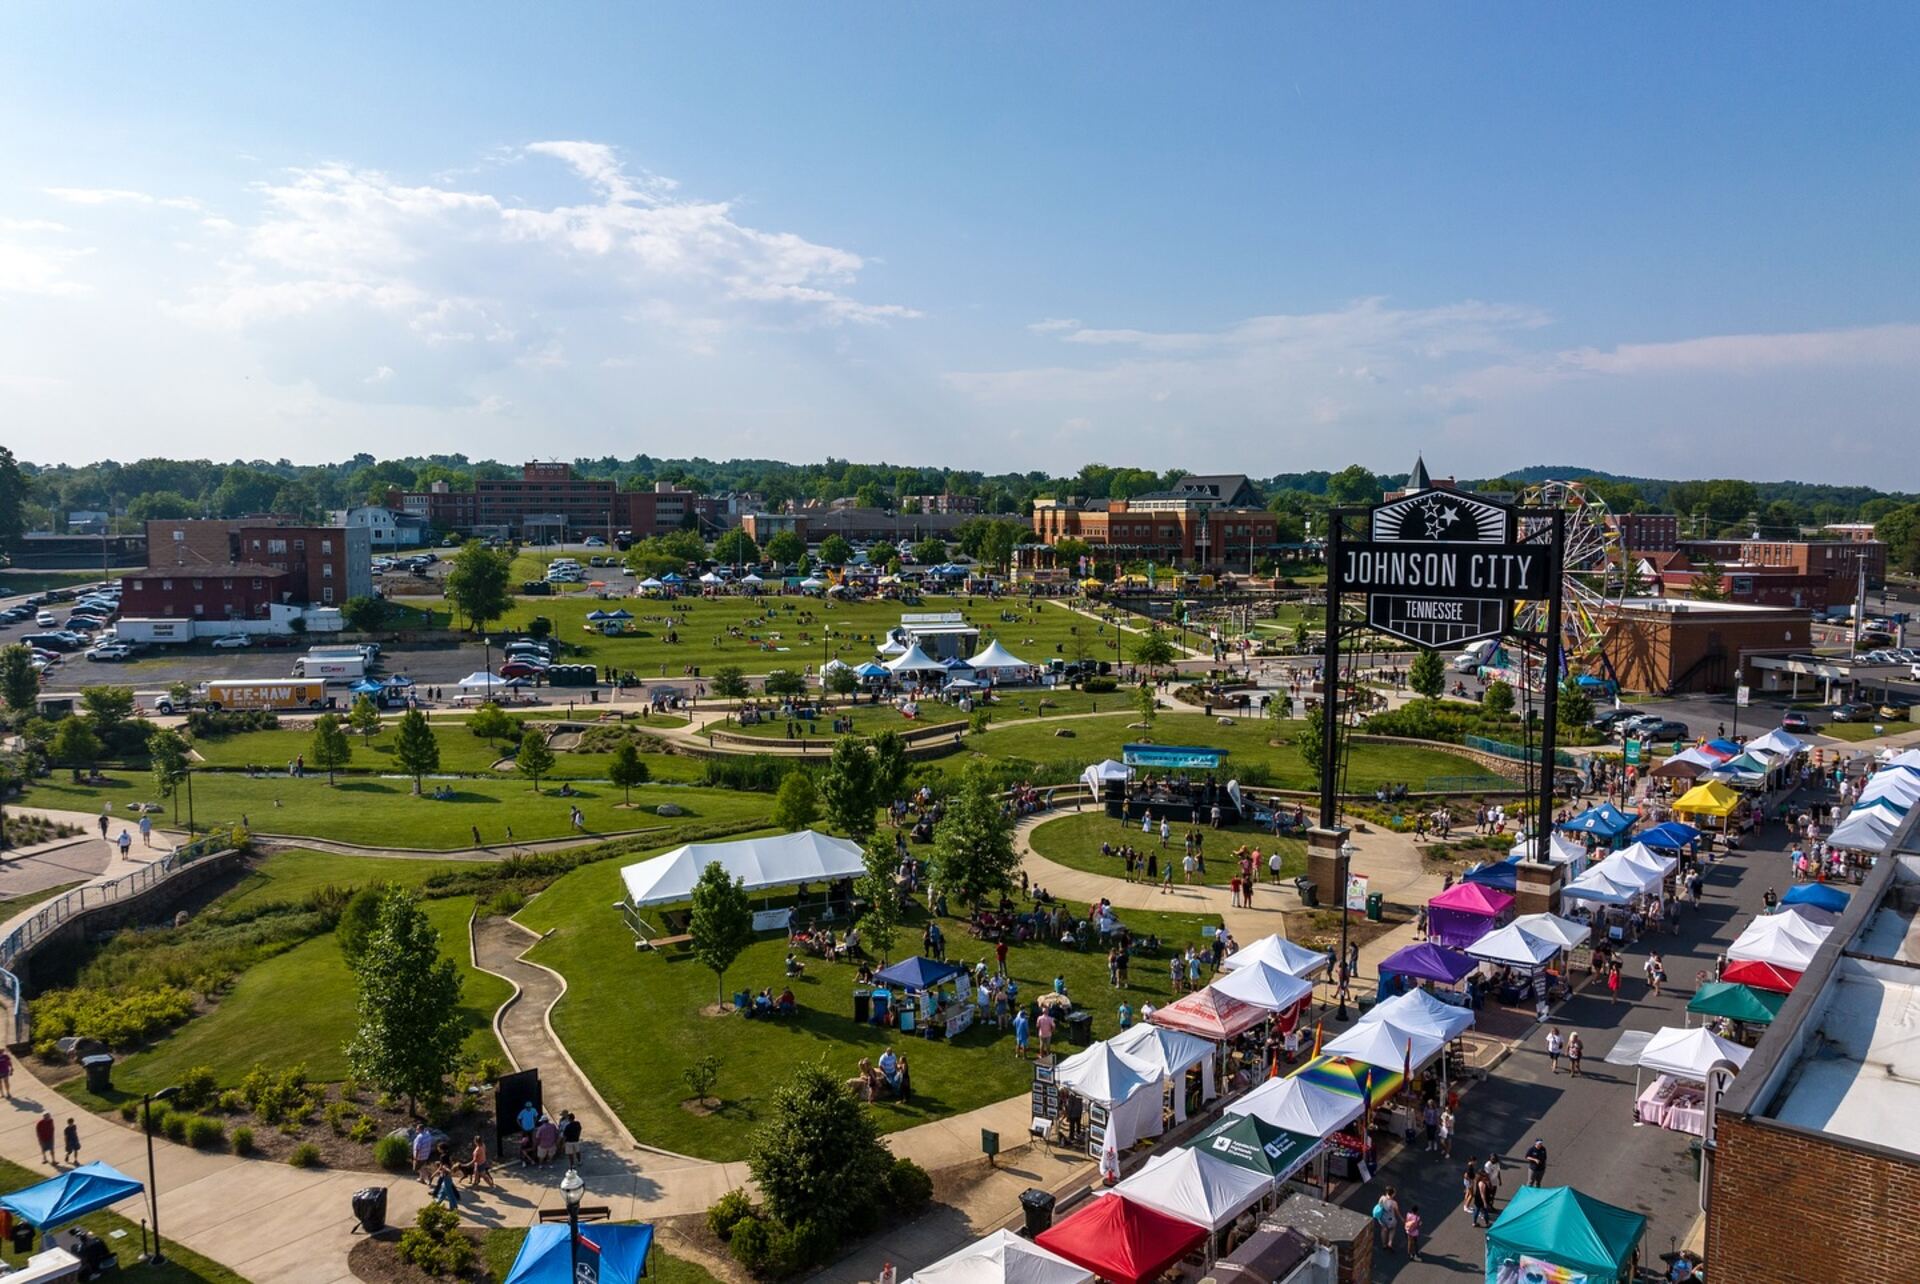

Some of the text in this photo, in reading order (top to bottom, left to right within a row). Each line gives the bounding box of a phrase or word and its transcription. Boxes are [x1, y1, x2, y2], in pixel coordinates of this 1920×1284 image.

[1344, 551, 1532, 590] JOHNSON CITY
[1405, 600, 1464, 621] TENNESSEE
[220, 687, 292, 701] YEE-HAW
